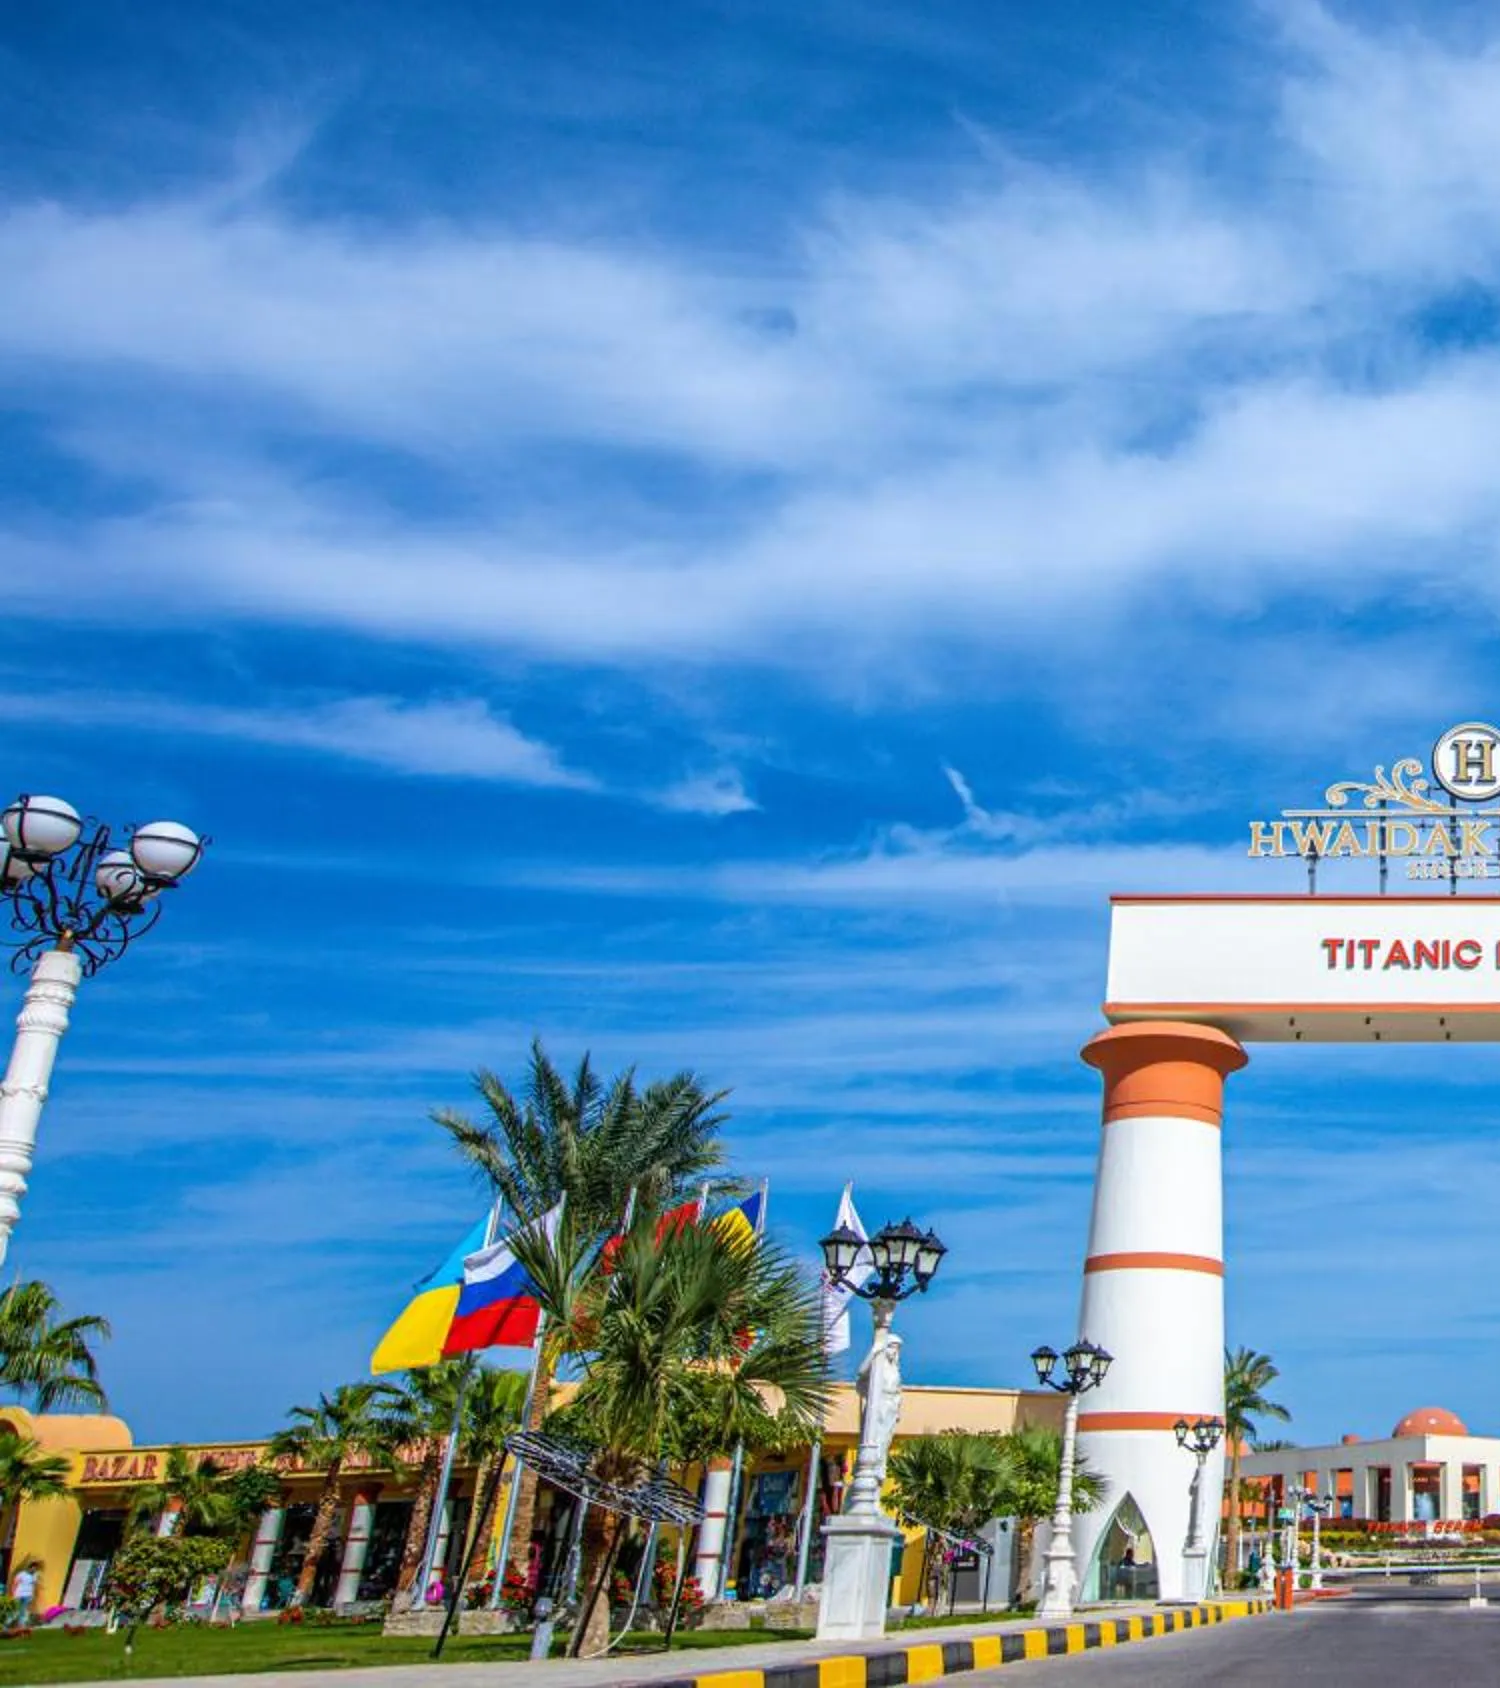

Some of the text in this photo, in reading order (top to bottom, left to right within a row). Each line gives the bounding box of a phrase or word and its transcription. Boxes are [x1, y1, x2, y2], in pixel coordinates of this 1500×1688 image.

[1450, 739, 1498, 786] H
[1248, 821, 1492, 858] HWAIDAK
[1321, 938, 1483, 970] TITANIC
[81, 1455, 158, 1481] BAZAR
